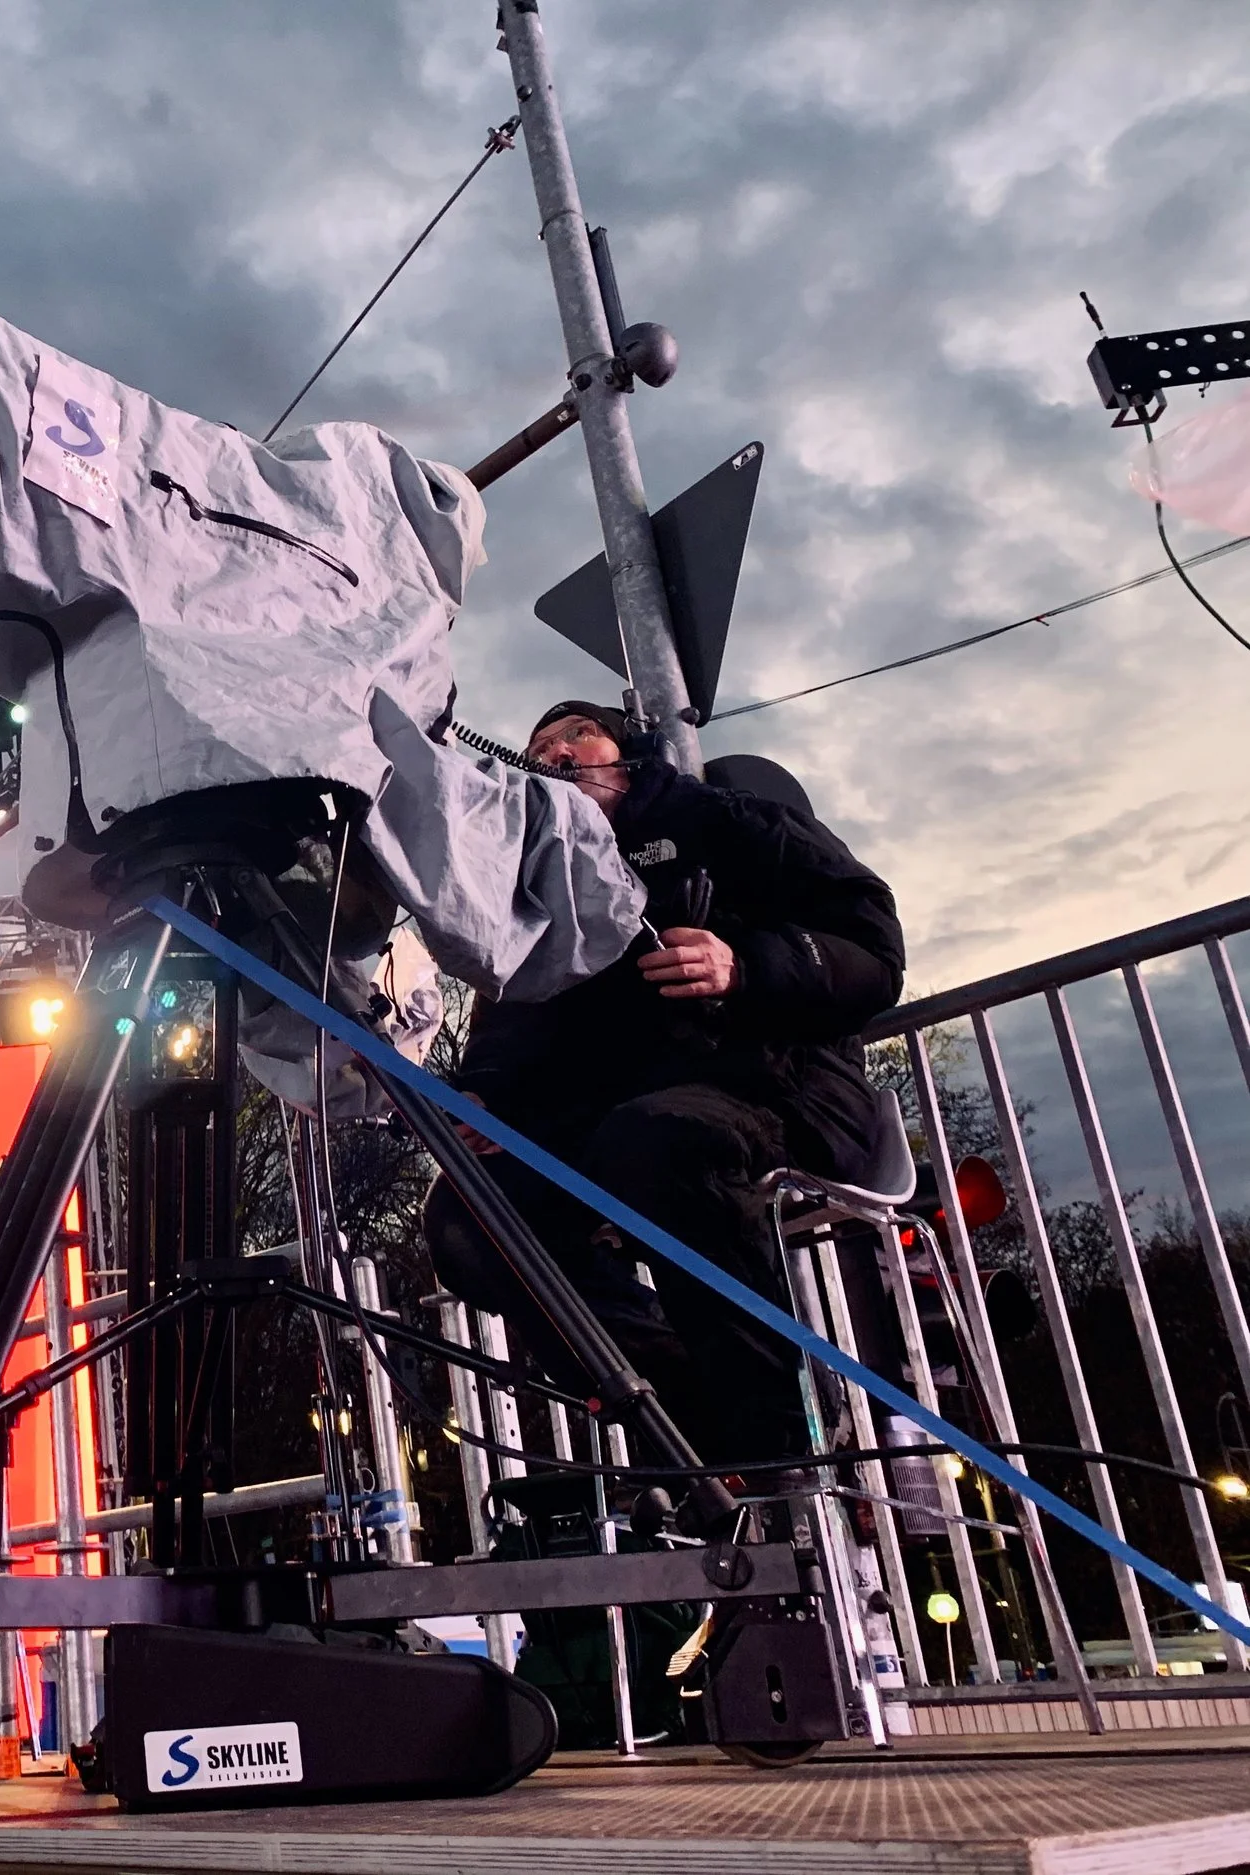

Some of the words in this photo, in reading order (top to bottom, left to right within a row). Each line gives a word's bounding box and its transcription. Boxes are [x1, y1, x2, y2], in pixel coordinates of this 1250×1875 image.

[644, 841, 661, 851] THE
[630, 848, 661, 860] NORTH
[639, 855, 661, 867] FACE
[207, 1741, 289, 1769] SKYLINE
[210, 1769, 291, 1782] TELEVISION
